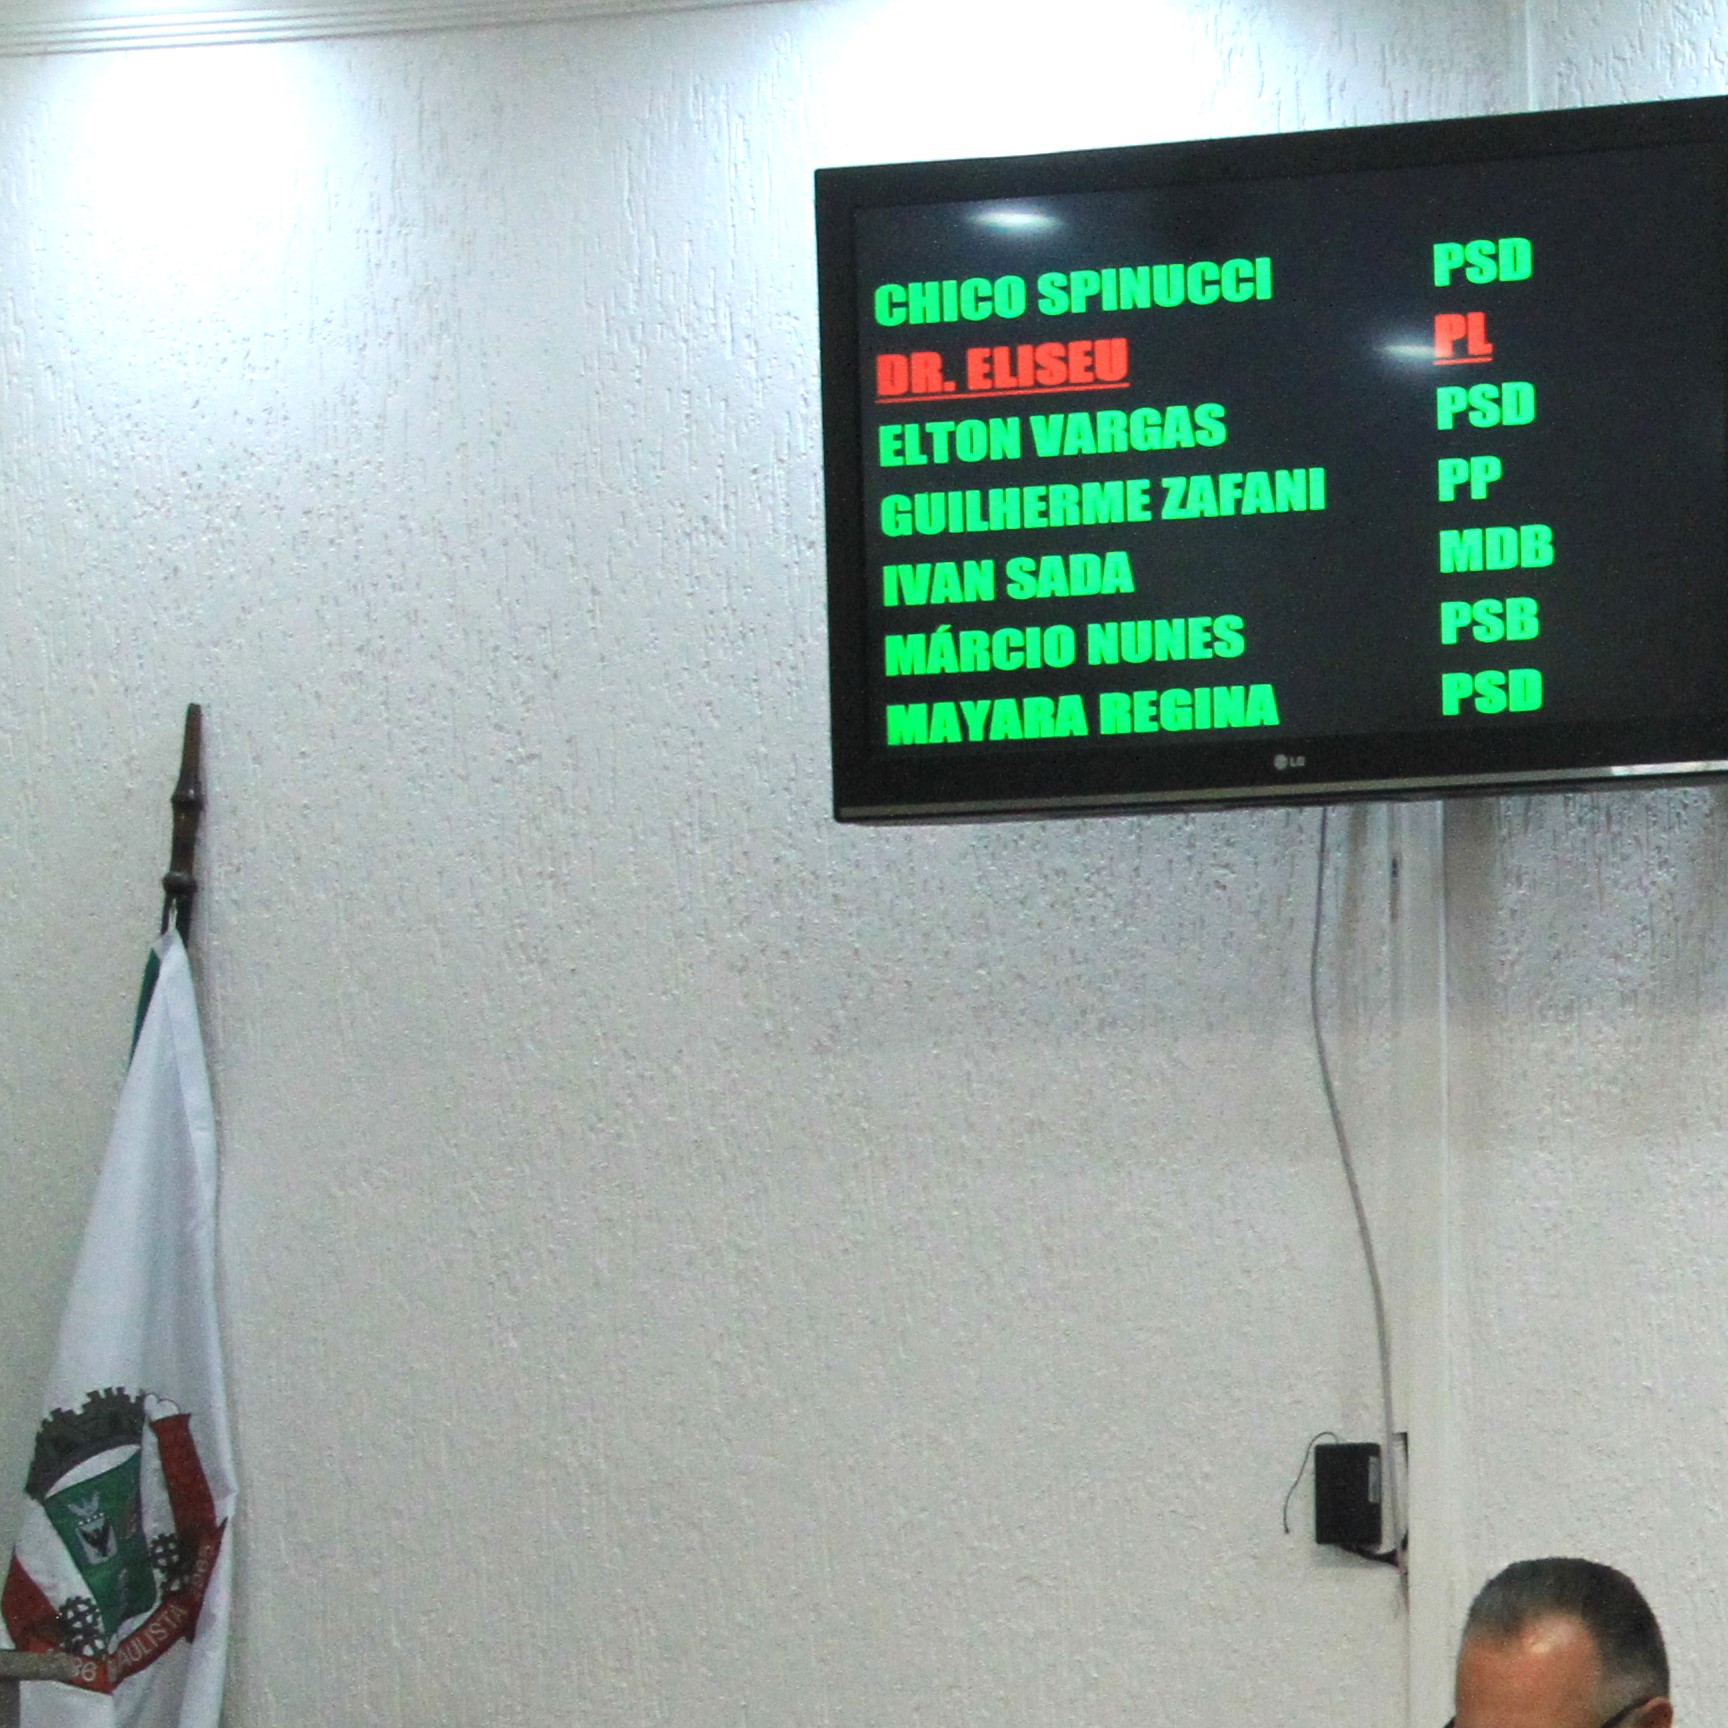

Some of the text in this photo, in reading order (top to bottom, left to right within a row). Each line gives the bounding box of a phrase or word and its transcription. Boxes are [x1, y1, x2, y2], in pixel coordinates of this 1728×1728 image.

[1432, 237, 1533, 288] PSD
[874, 256, 1273, 327] CHICO SPINUCCI
[1433, 311, 1494, 358] PL
[876, 337, 1130, 397] DR. ELISEU
[1435, 381, 1536, 431] PSD
[878, 402, 1227, 468] ELTON VARGAS
[880, 466, 1326, 538] GUILHERME ZAFANI
[1437, 455, 1503, 503] PP
[1438, 523, 1555, 574] MDB
[882, 550, 1136, 607] IVAN SADA
[884, 614, 1246, 677] MÁRCIO NUNES
[1440, 596, 1540, 645] PSB
[885, 683, 1280, 746] MAYARA REGINA
[1441, 668, 1543, 716] PSD
